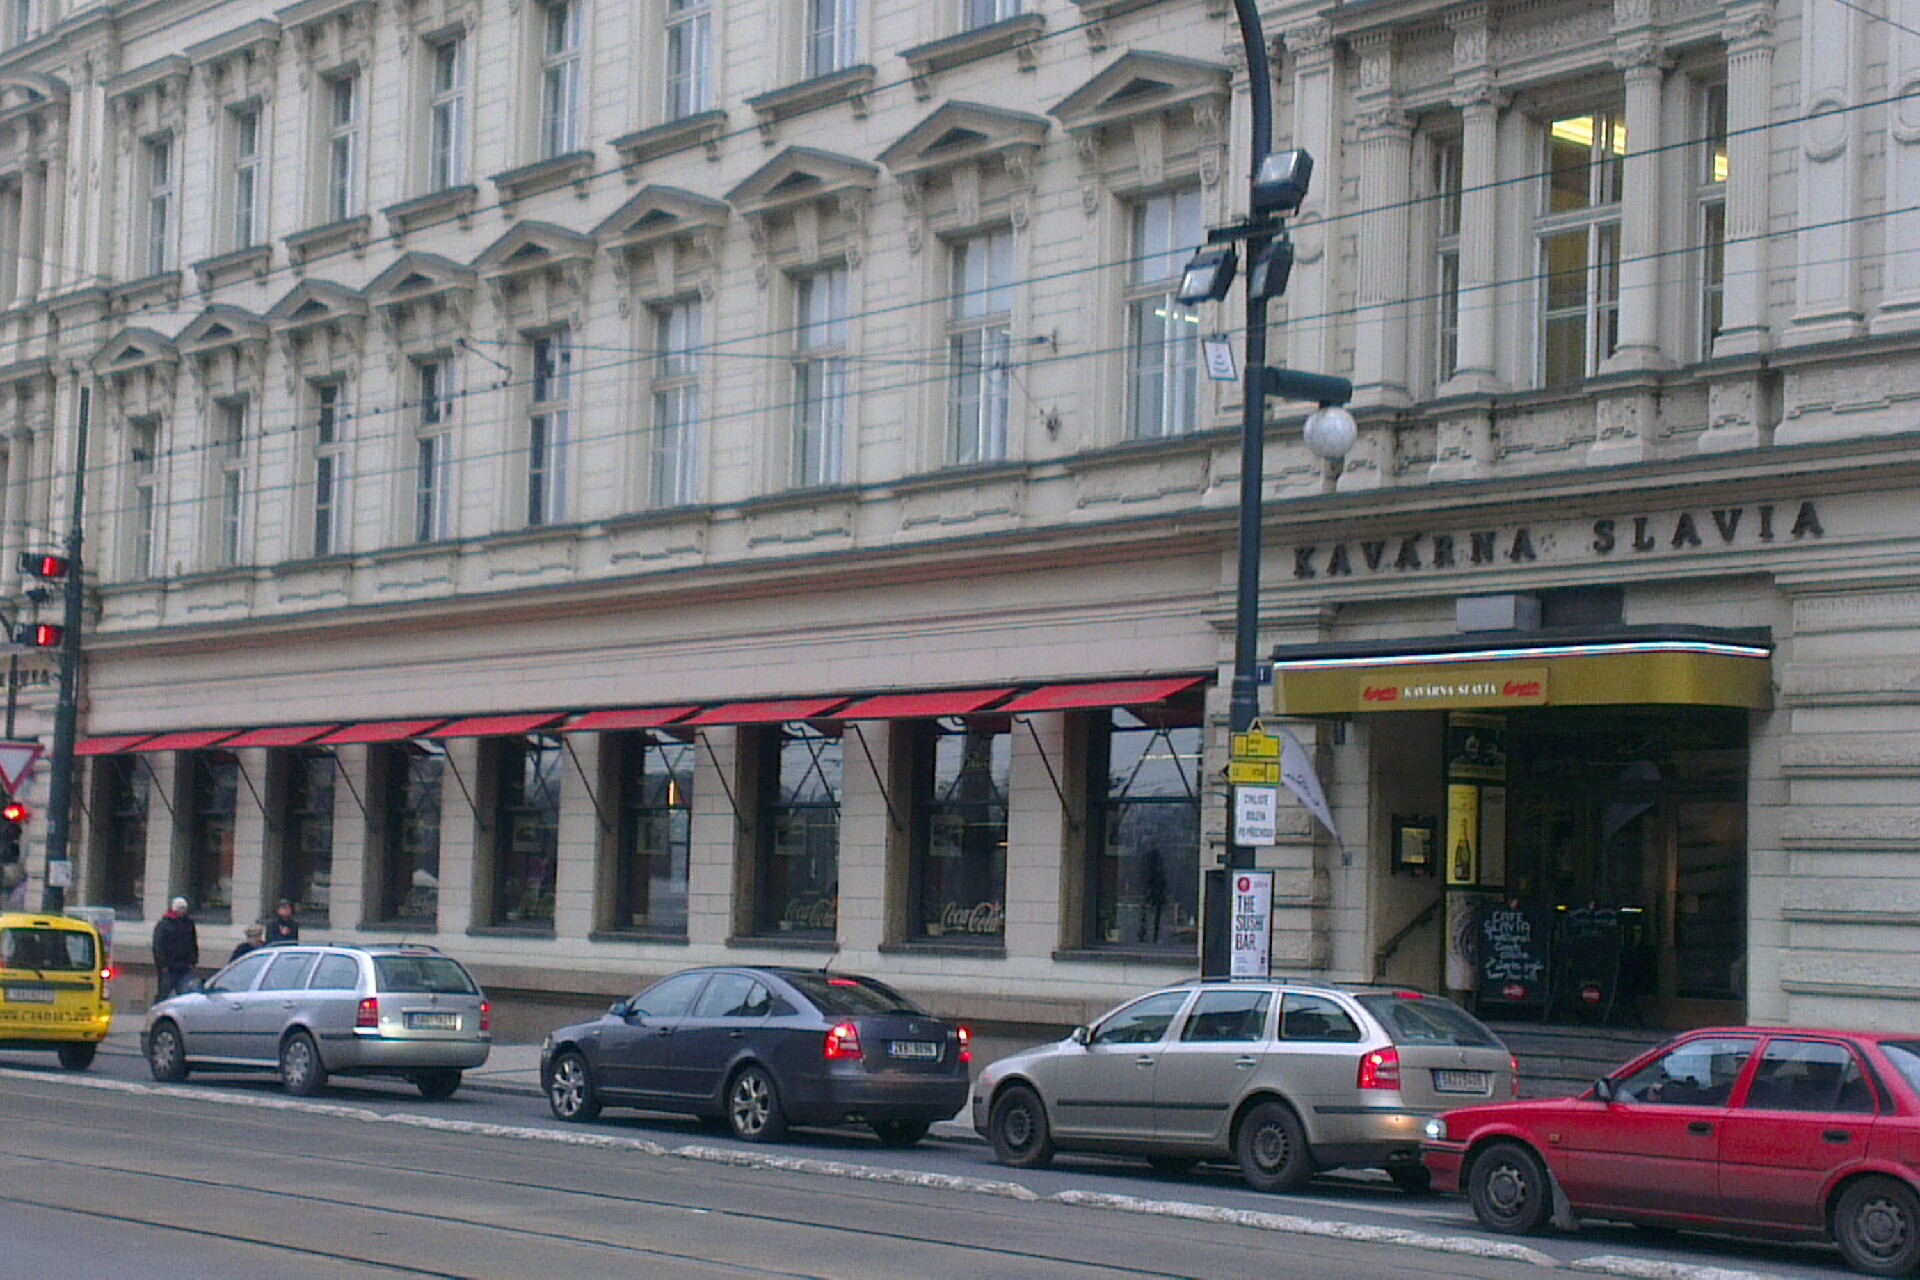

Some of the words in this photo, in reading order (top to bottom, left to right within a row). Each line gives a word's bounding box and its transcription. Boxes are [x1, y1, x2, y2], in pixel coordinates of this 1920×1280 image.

[1294, 529, 1536, 577] KAVÁRNA
[1593, 502, 1824, 552] SLAVIA
[1238, 895, 1255, 913] THE
[1236, 914, 1265, 931] SUSHI
[1235, 933, 1256, 951] BAR
